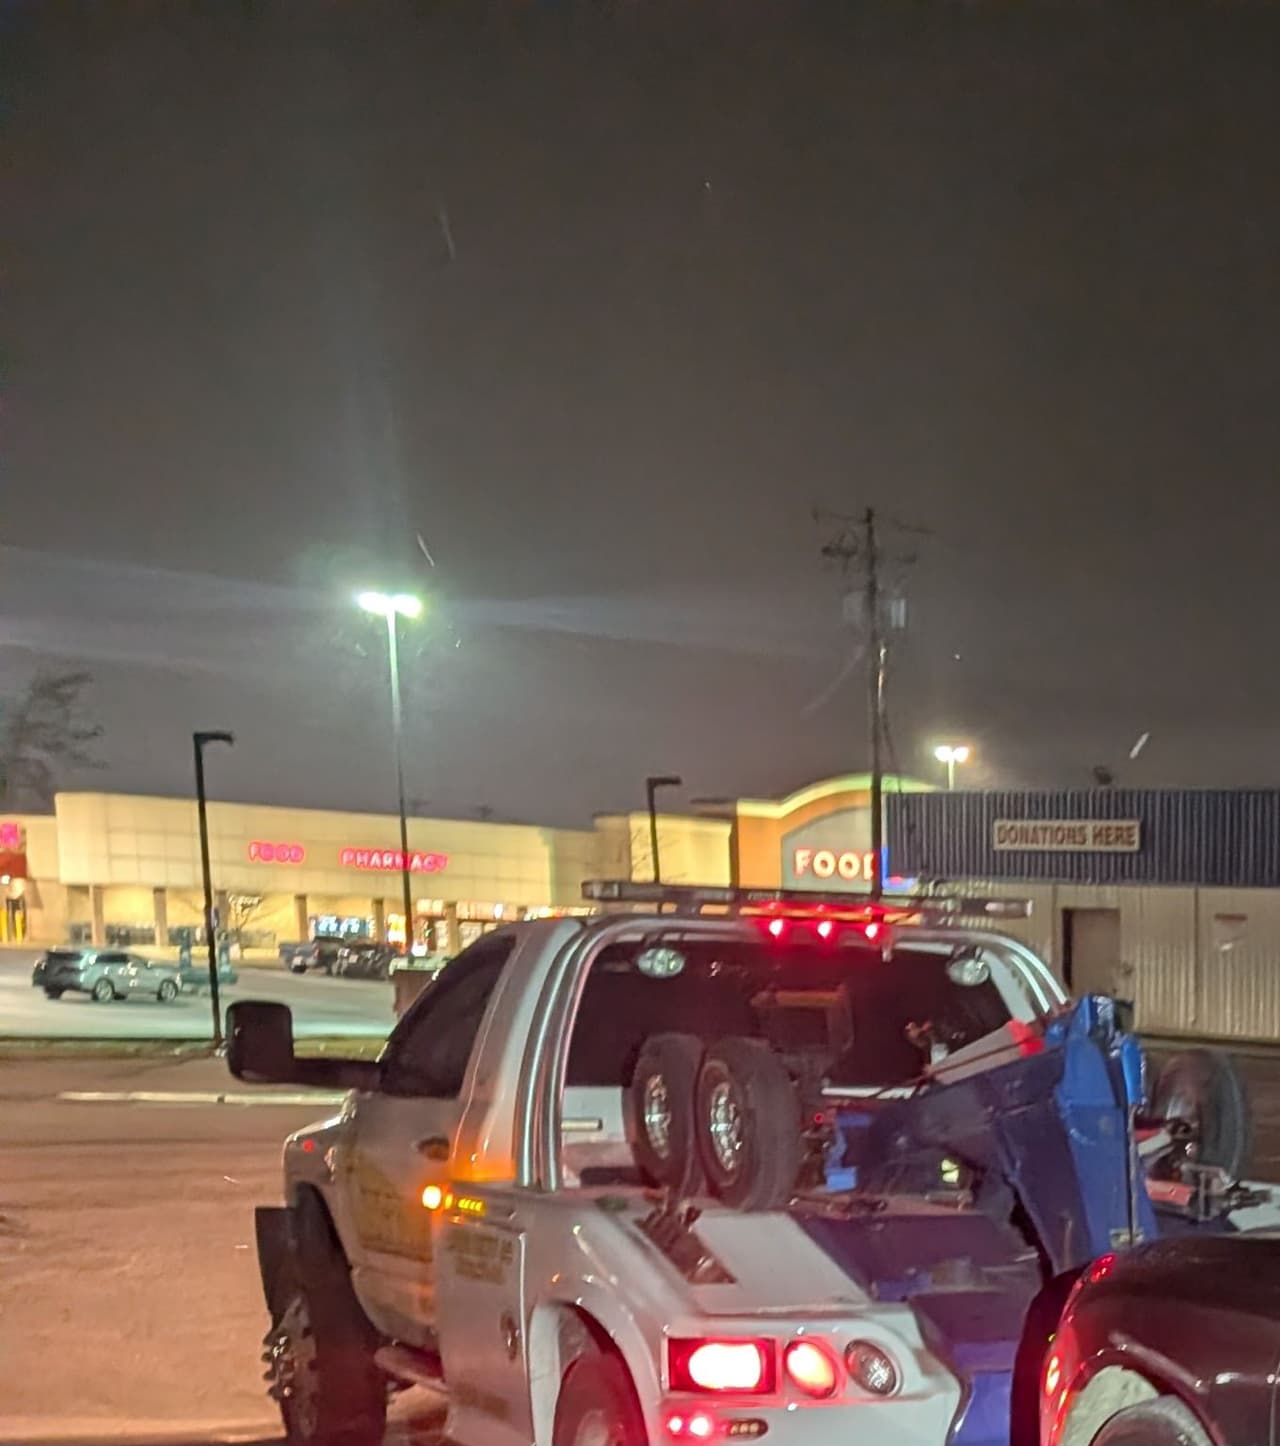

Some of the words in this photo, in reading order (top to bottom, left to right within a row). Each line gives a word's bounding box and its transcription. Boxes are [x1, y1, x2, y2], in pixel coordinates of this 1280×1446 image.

[998, 825, 1087, 847] DONATIONS
[1093, 826, 1137, 847] HERE
[249, 841, 303, 863] FOOD
